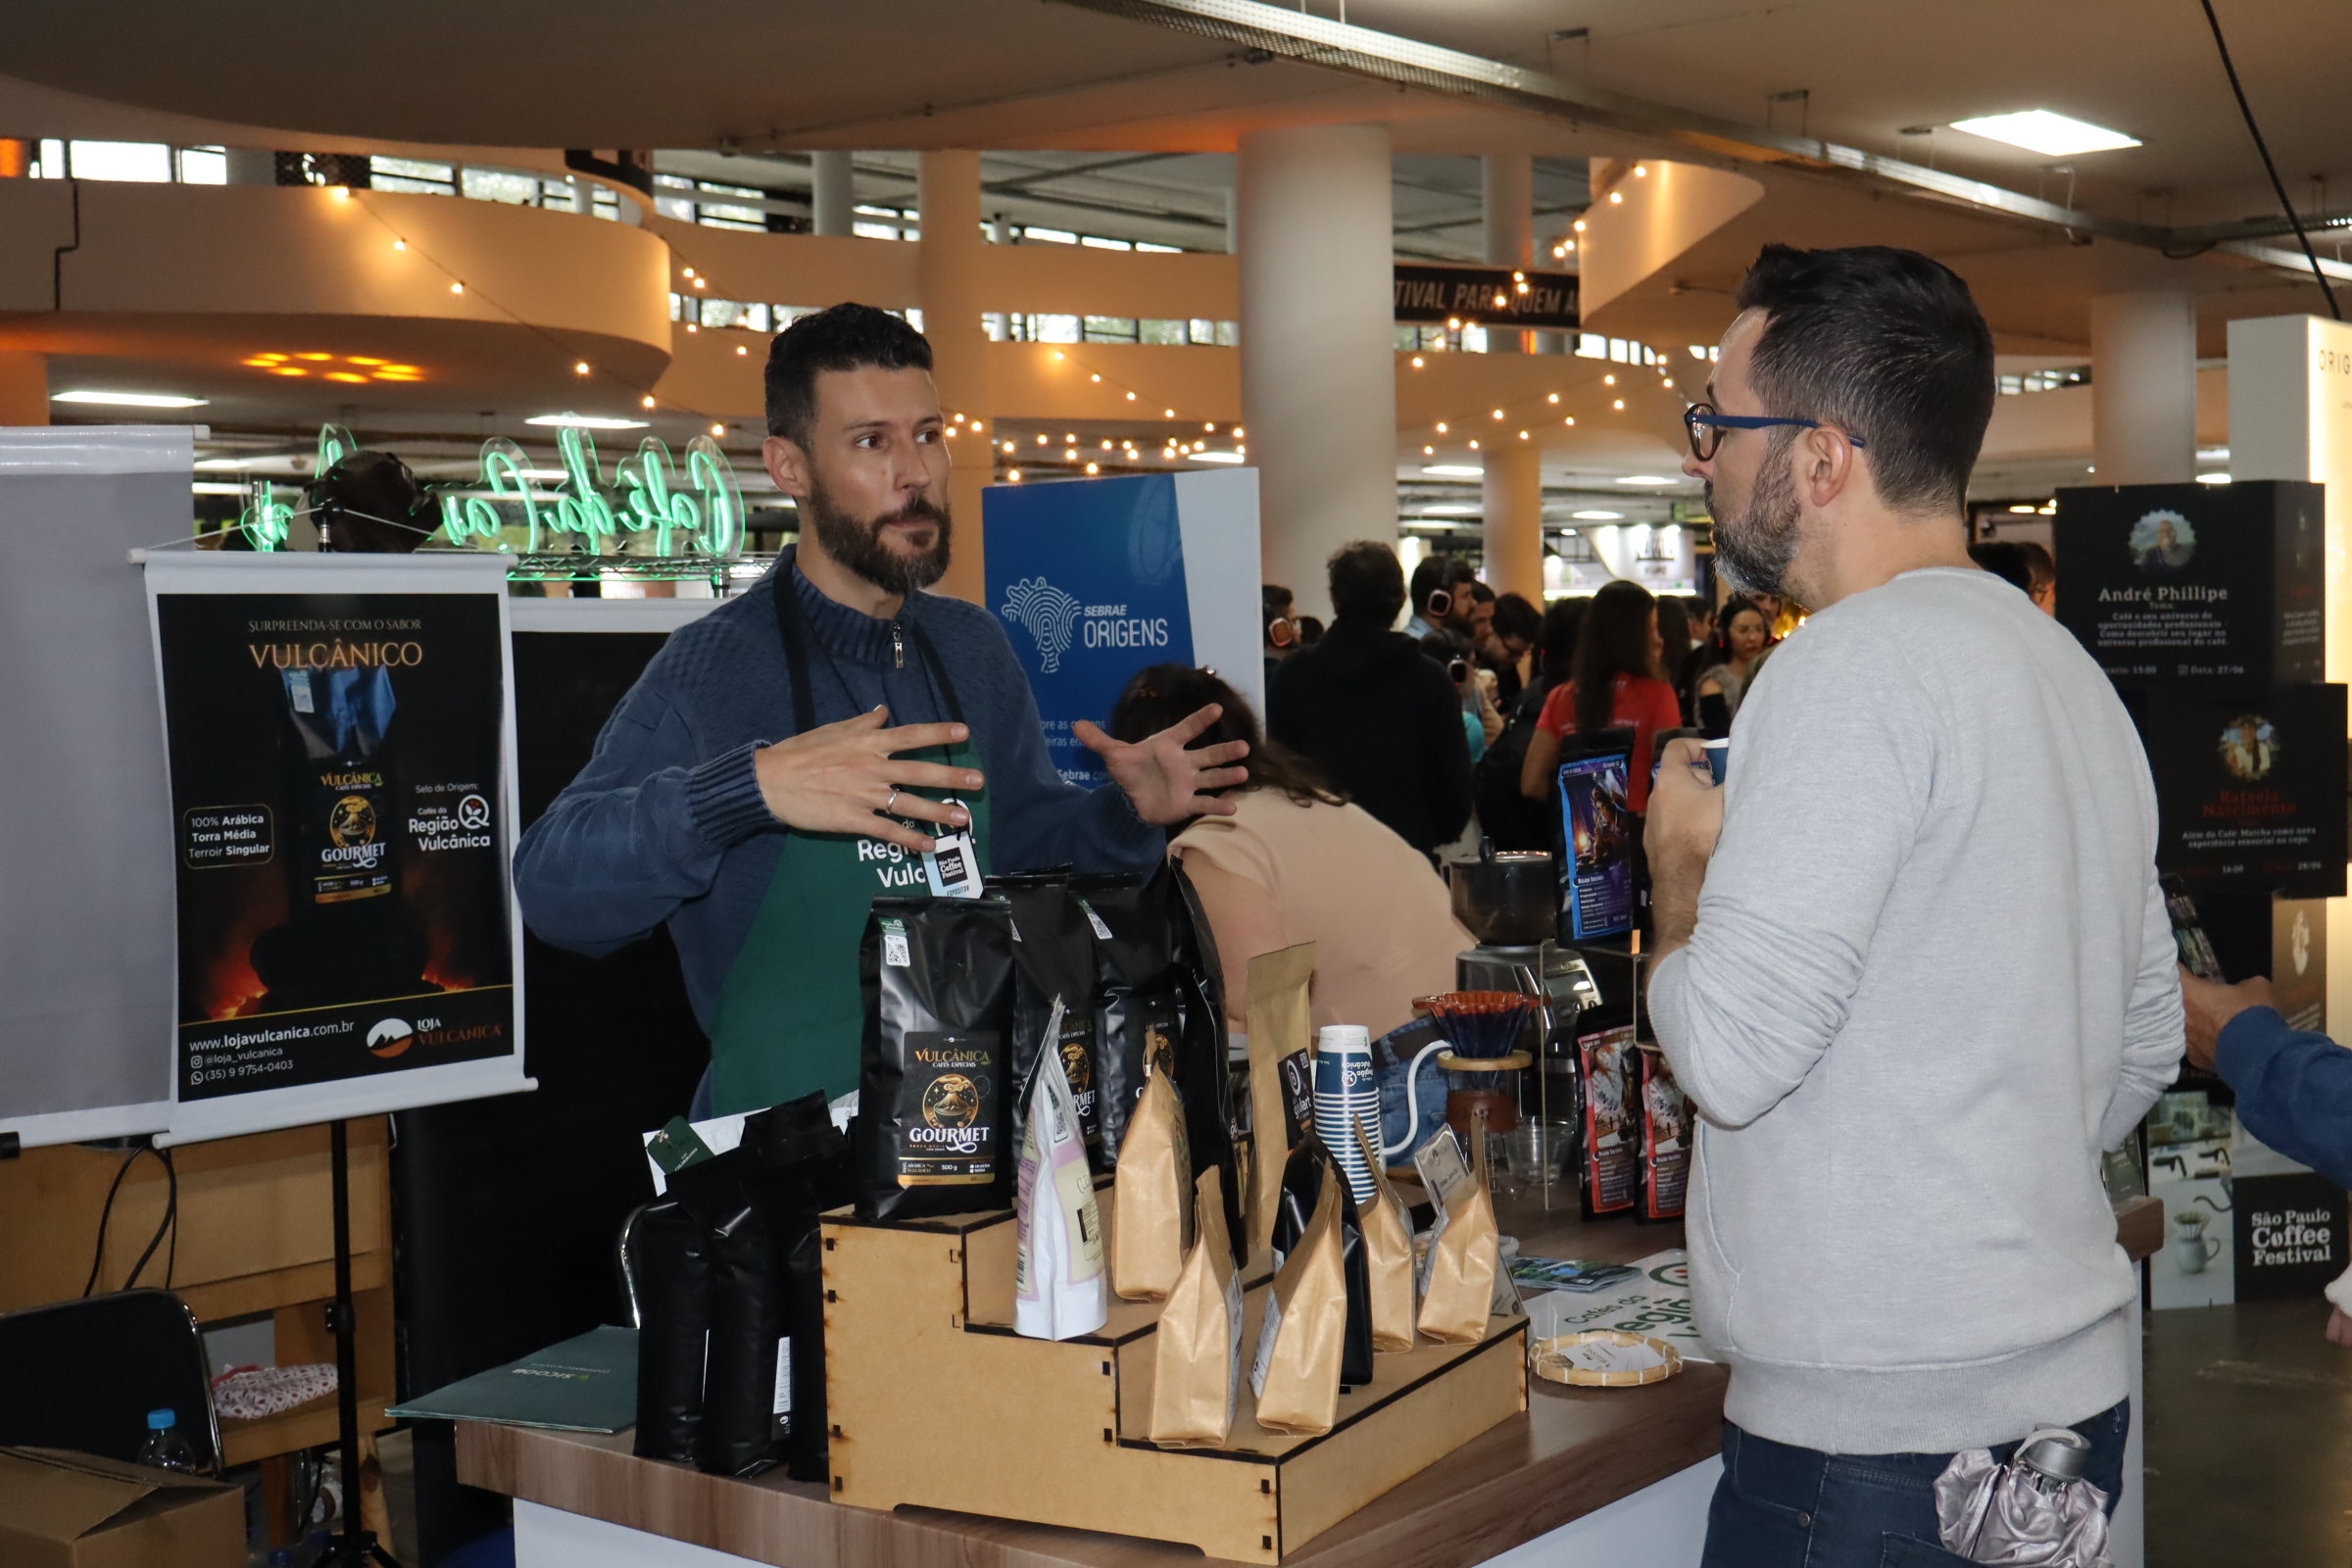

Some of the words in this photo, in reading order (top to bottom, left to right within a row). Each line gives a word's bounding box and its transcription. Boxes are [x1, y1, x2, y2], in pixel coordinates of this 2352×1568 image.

[1509, 287, 1561, 316] QUEM
[2098, 587, 2152, 602] André
[2157, 586, 2228, 603] Phillipe
[1084, 604, 1127, 616] SEBRAE
[249, 619, 341, 632] SURPREENDA-SE
[344, 619, 371, 631] COM
[374, 619, 384, 630] O
[386, 618, 421, 630] SABOR
[2164, 620, 2222, 629] profissionais
[1084, 617, 1168, 648] ORIGENS
[2099, 629, 2125, 638] Como
[2188, 629, 2212, 638] lugar
[2137, 638, 2191, 648] profissional
[1046, 736, 1067, 746] eiras
[1057, 769, 1090, 780] Sebrae
[447, 783, 478, 792] Origem:
[191, 816, 219, 828] 100%
[222, 813, 265, 826] Arábica
[409, 815, 459, 835] Região
[192, 832, 220, 843] Torra
[223, 829, 257, 841] Média
[418, 833, 491, 851] Vulcânica
[189, 846, 222, 858] Terroir
[225, 844, 270, 856] Singular
[321, 843, 386, 868] GOURMET
[940, 861, 962, 873] Coffee
[942, 867, 964, 879] Festival
[947, 884, 969, 896] EXPOSITOR
[417, 1018, 441, 1032] LOJA
[190, 1020, 355, 1052] www.lojavulcanica.com.br
[206, 1048, 283, 1064] @loja_vulcanica
[915, 1048, 991, 1064] VULCÂNICA
[205, 1068, 226, 1081] (35)
[228, 1066, 236, 1077] 9
[238, 1059, 293, 1076] 9754-0403
[909, 1127, 990, 1153] GOURMET
[2251, 1211, 2282, 1227] São
[2284, 1207, 2330, 1224] Paulo
[2252, 1224, 2331, 1249] Coffee
[2252, 1245, 2331, 1266] Festival
[1564, 1303, 1623, 1324] Cafés
